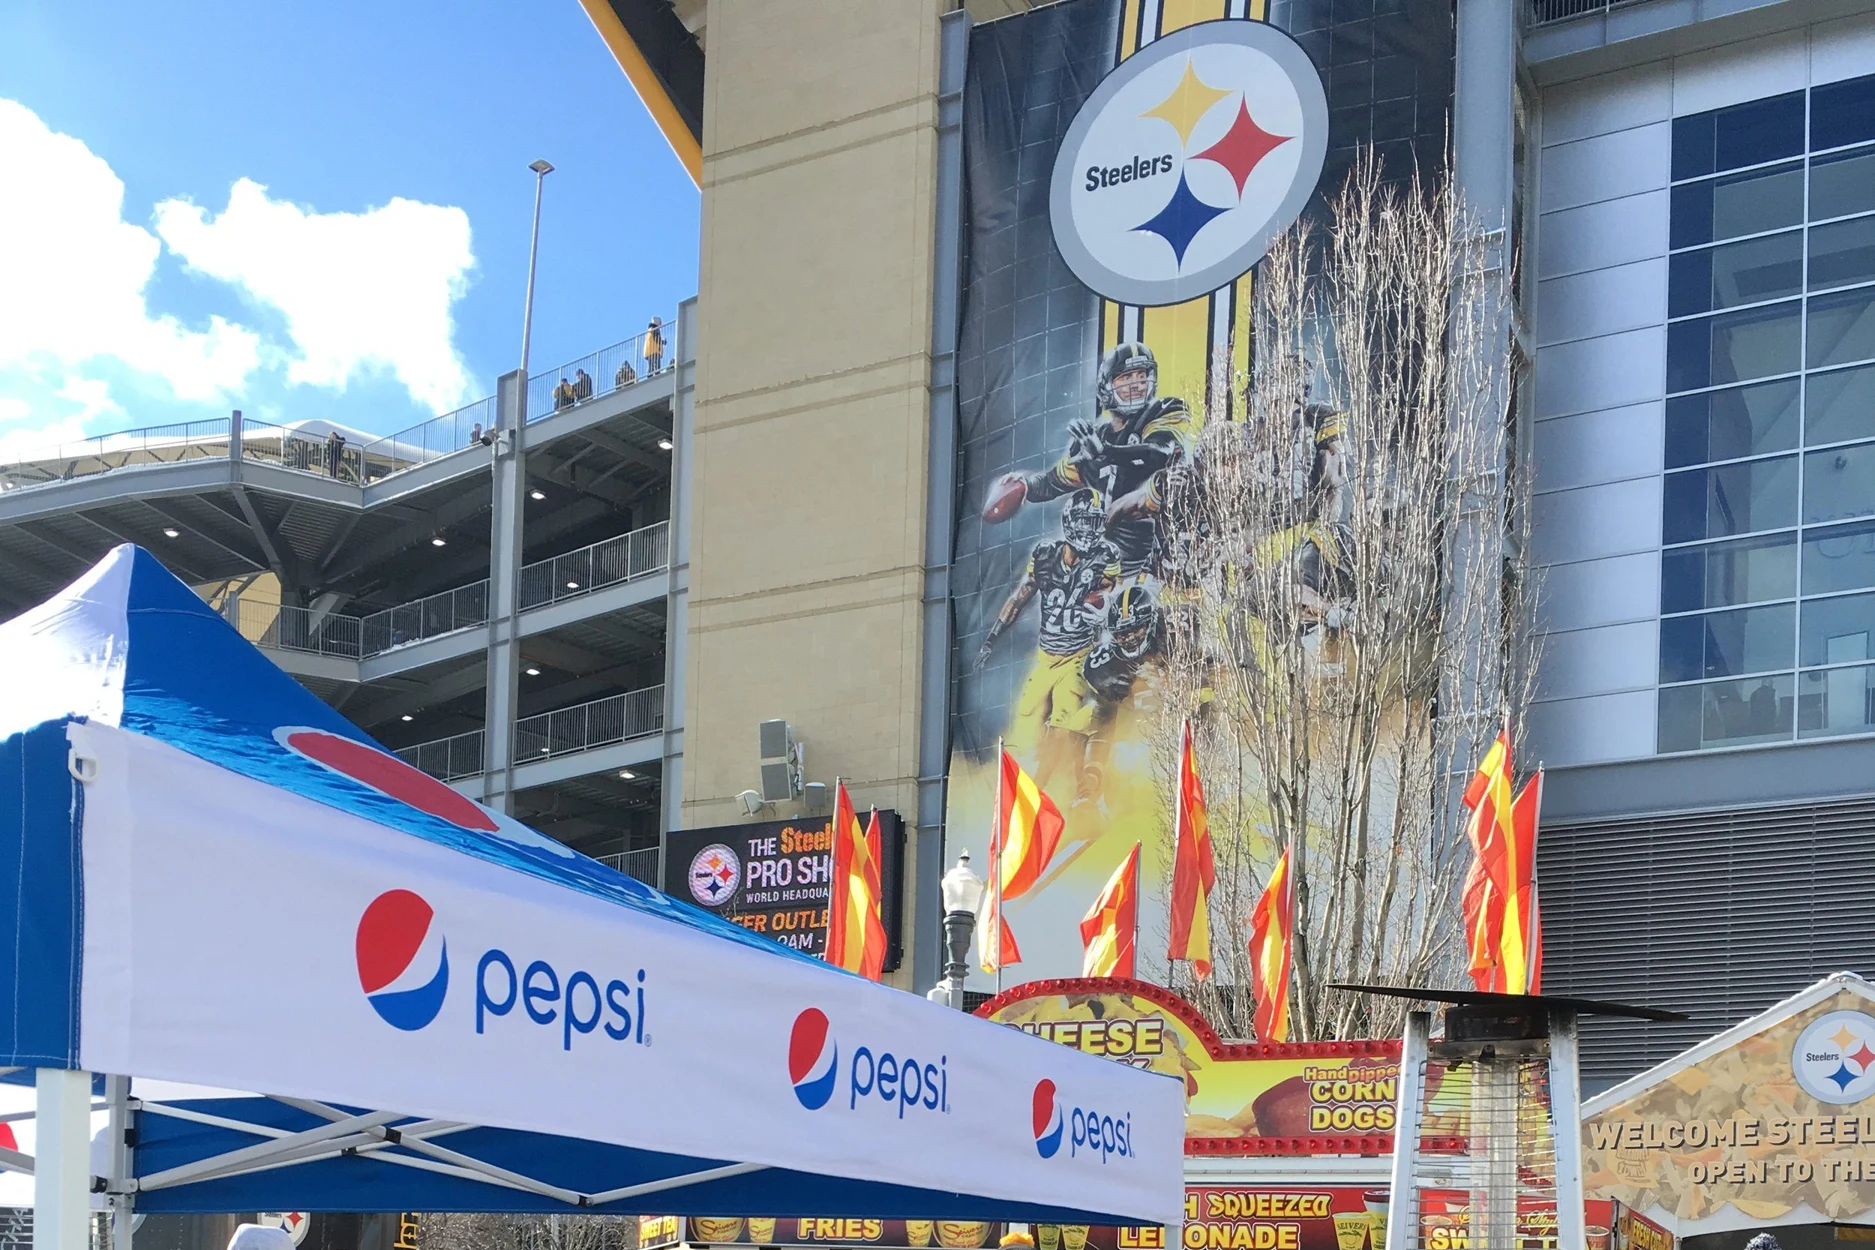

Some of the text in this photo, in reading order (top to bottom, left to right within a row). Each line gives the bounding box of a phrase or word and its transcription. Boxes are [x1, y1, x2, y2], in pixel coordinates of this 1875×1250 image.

[1085, 154, 1173, 192] Steelers
[748, 823, 832, 857] THE Steel
[746, 855, 832, 889] PRO SH
[746, 887, 829, 904] WORLD HEADQUA
[772, 910, 828, 931] OUTLE
[476, 949, 646, 1051] pepsi
[1805, 1051, 1840, 1063] Steelers
[851, 1046, 947, 1119] pepsi
[1311, 1080, 1397, 1104] CORN
[1311, 1105, 1396, 1131] DOGS
[1071, 1107, 1133, 1165] pepsi
[1590, 1119, 1760, 1150] WELCOME
[1688, 1161, 1766, 1184] OPEN
[1776, 1159, 1814, 1183] TO
[1207, 1192, 1332, 1219] SQUEEZED
[798, 1217, 883, 1240] FRIES
